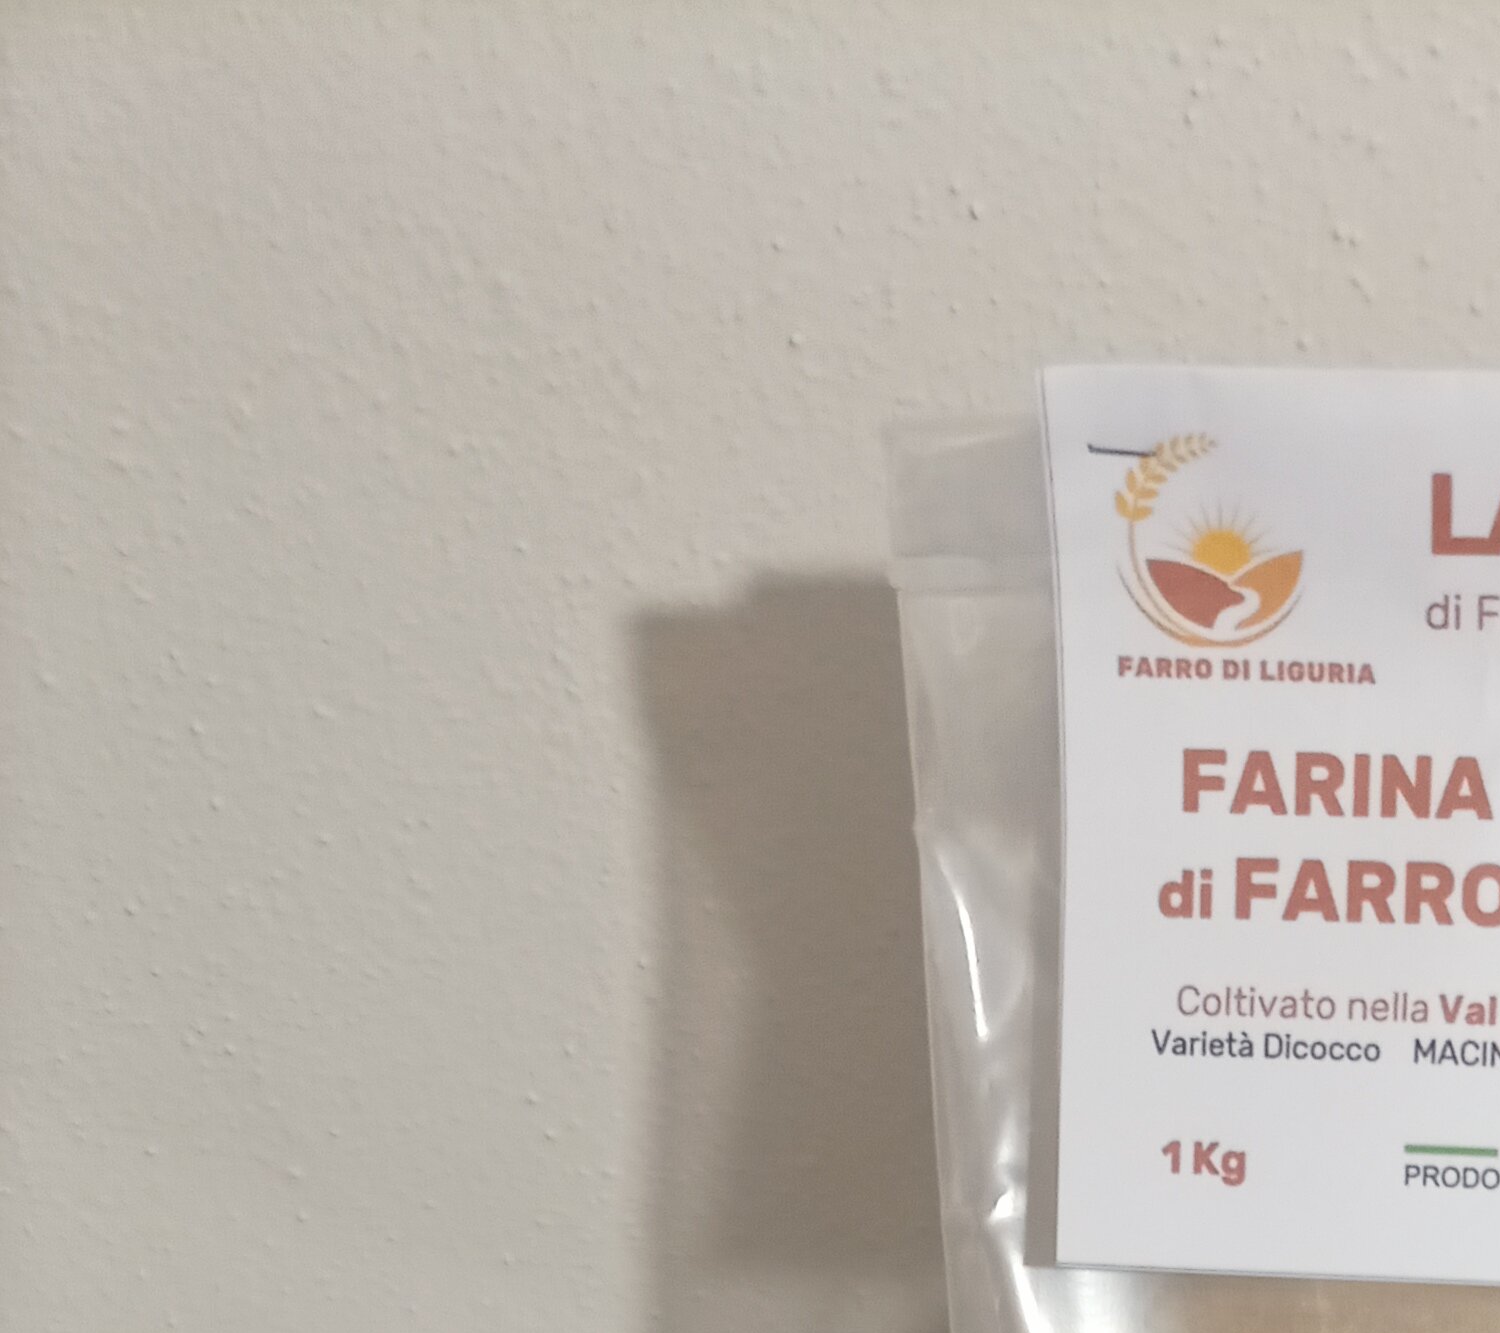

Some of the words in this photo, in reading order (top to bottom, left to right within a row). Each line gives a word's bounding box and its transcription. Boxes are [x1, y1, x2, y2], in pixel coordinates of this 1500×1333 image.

[1425, 594, 1462, 631] di
[1117, 655, 1213, 680] FARRO
[1222, 658, 1251, 681] DI
[1259, 659, 1377, 685] LIGURIA
[1182, 747, 1494, 821] FARINA
[1157, 867, 1214, 920] di
[1176, 984, 1337, 1021] Coltivato
[1347, 991, 1429, 1024] nella
[1438, 993, 1498, 1026] Val
[1151, 1028, 1254, 1058] Varietà
[1263, 1032, 1381, 1063] Dicocco
[1161, 1139, 1182, 1175] 1
[1192, 1140, 1247, 1187] Kg
